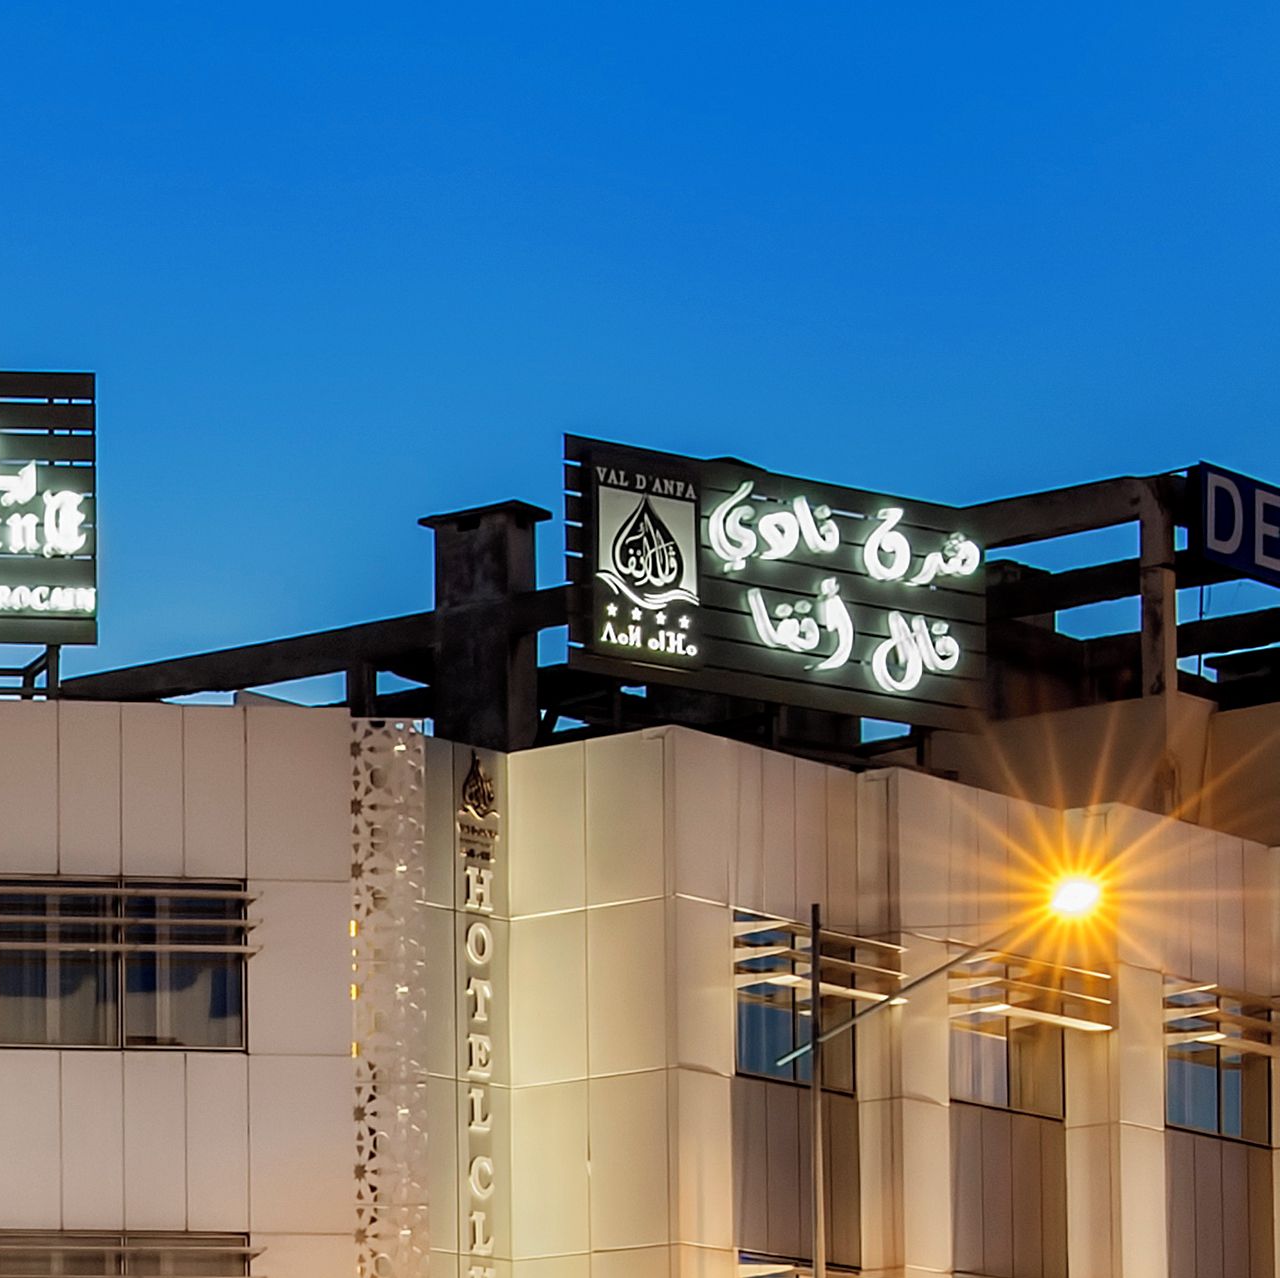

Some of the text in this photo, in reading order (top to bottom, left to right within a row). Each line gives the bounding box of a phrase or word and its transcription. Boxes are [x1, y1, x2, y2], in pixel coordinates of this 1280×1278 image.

[596, 467, 697, 499] VAL D'ANFA
[464, 866, 494, 1131] HOTEL
